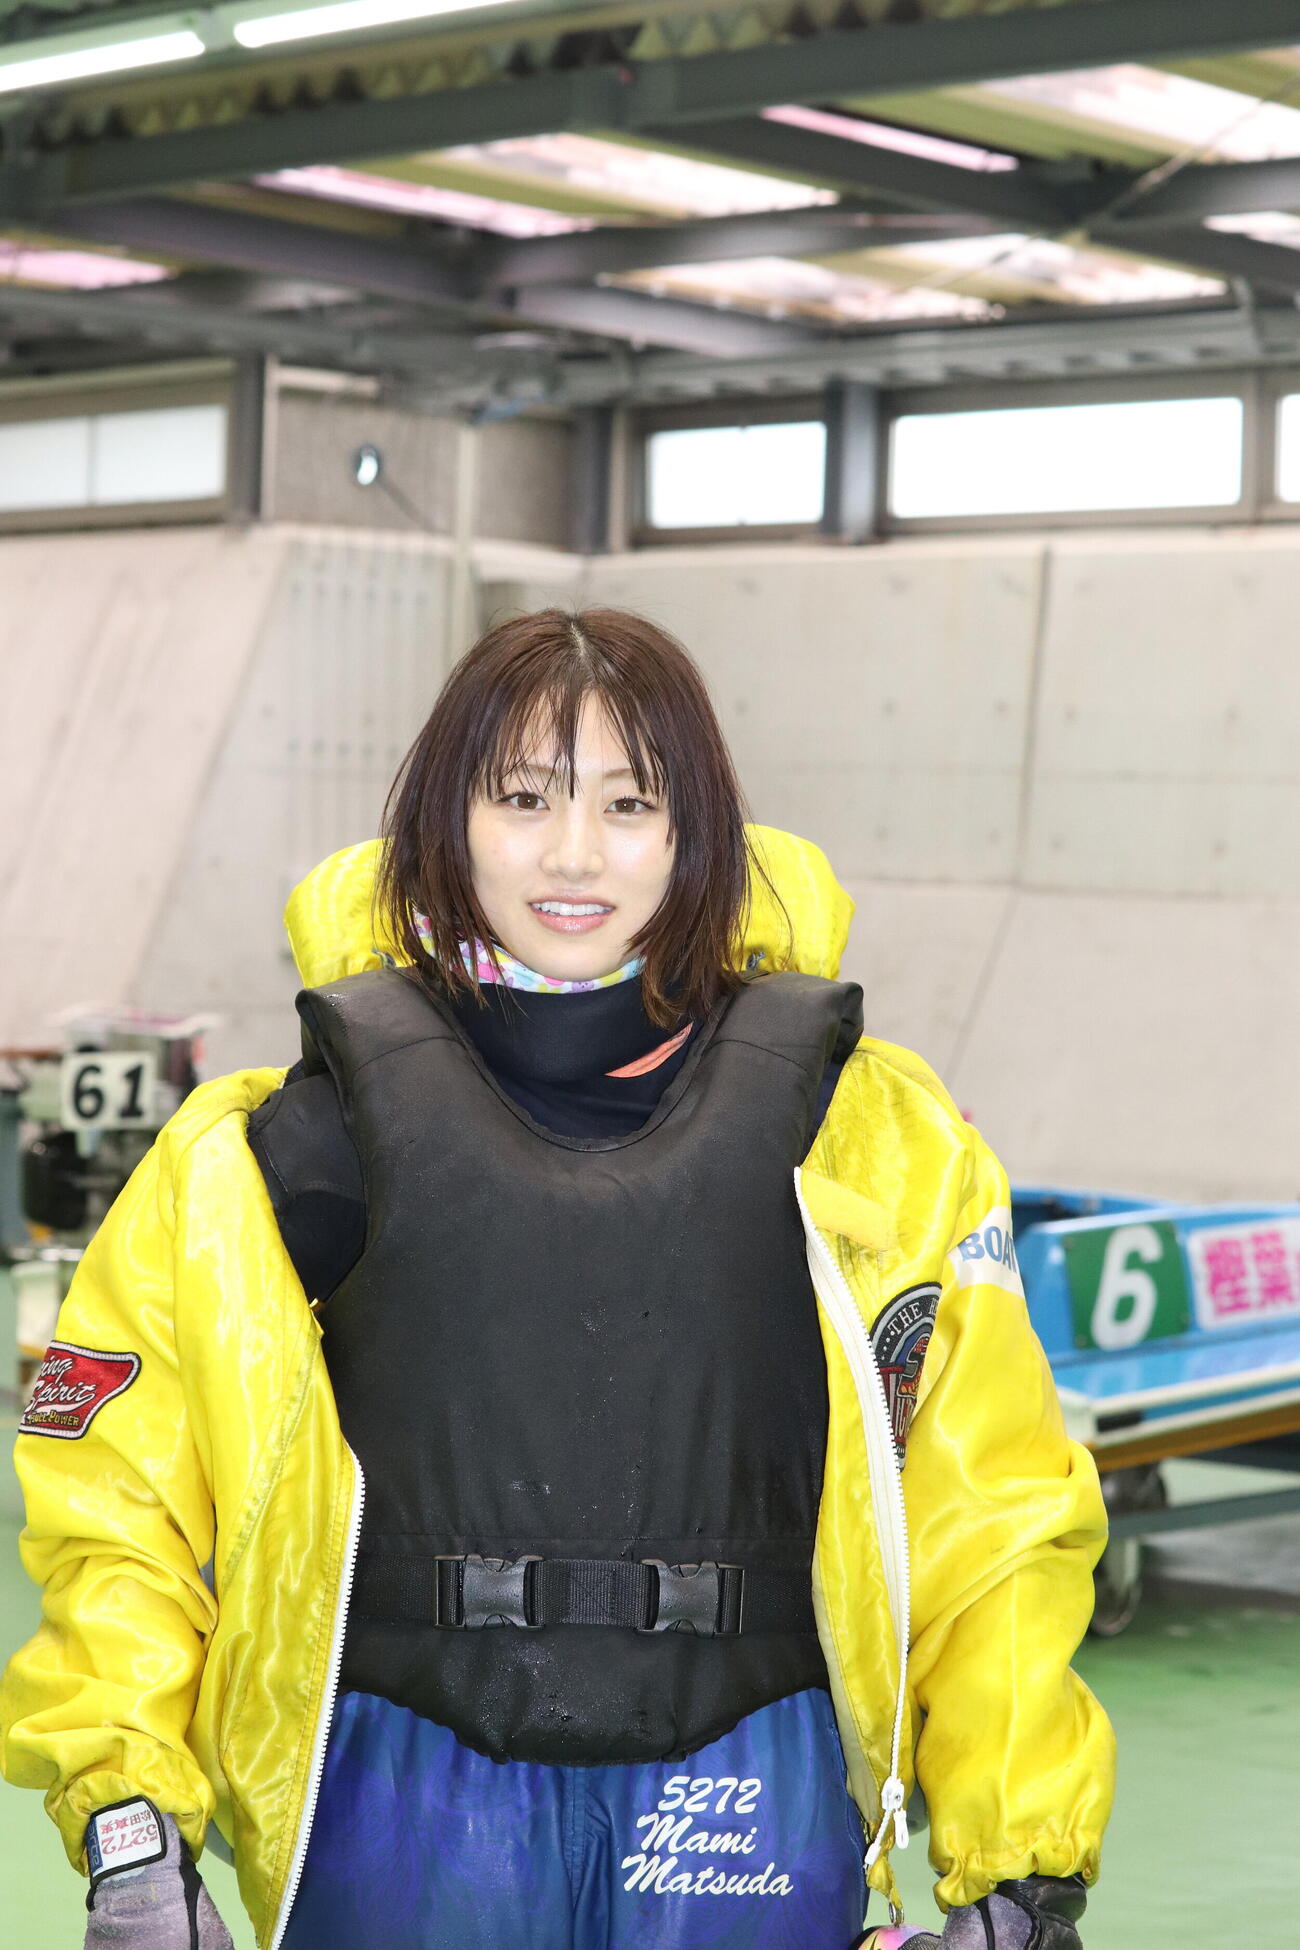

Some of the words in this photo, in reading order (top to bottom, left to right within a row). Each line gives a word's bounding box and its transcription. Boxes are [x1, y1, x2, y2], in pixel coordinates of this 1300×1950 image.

[73, 1064, 145, 1120] 61
[957, 1225, 1018, 1274] BOA
[1090, 1224, 1163, 1350] 6
[888, 1301, 923, 1336] THE
[657, 1775, 762, 1814] 5272
[101, 1823, 159, 1855] 5272
[636, 1812, 758, 1855] Mami
[621, 1853, 794, 1896] Matsuda
